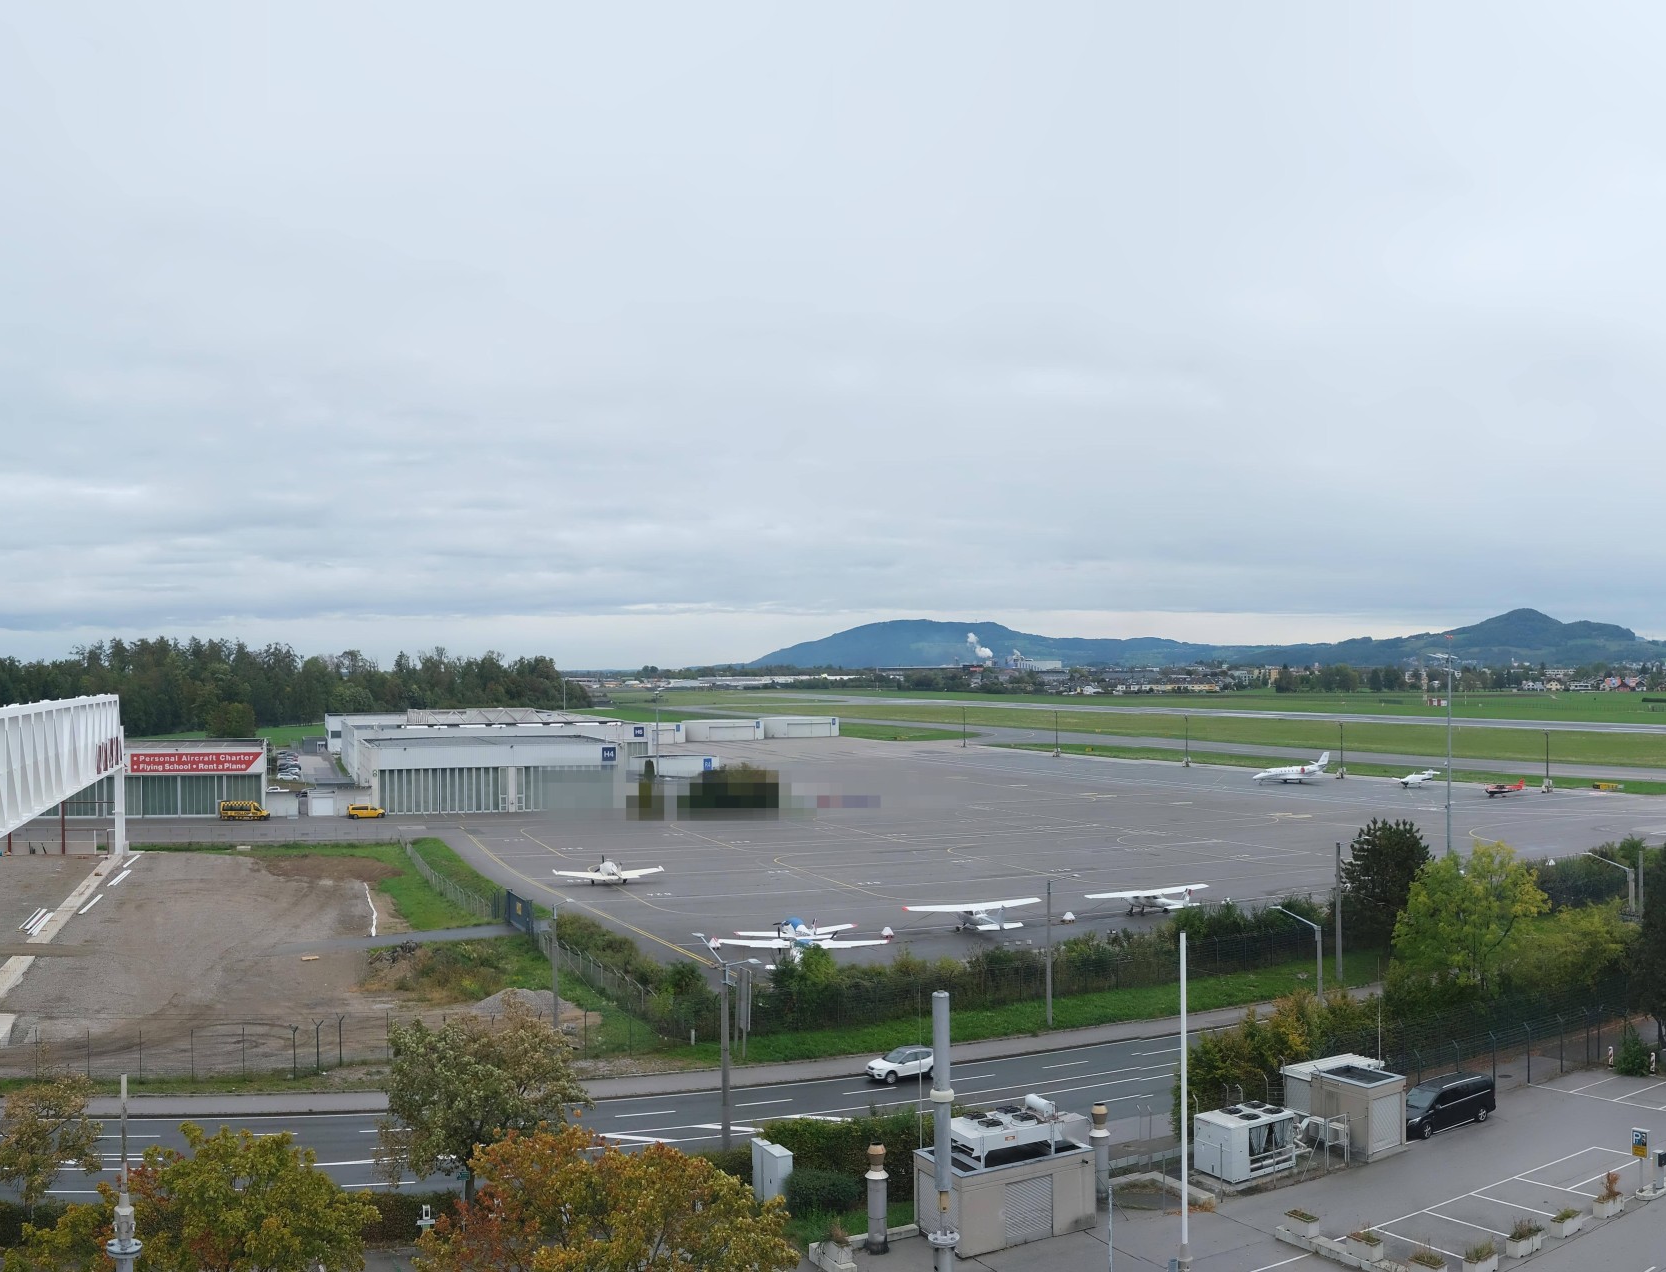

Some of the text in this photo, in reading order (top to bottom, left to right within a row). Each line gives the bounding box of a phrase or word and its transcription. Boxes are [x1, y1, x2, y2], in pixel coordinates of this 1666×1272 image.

[219, 753, 254, 761] Charter
[603, 750, 614, 758] H4
[139, 763, 163, 771] Flying
[1633, 1131, 1641, 1144] P
